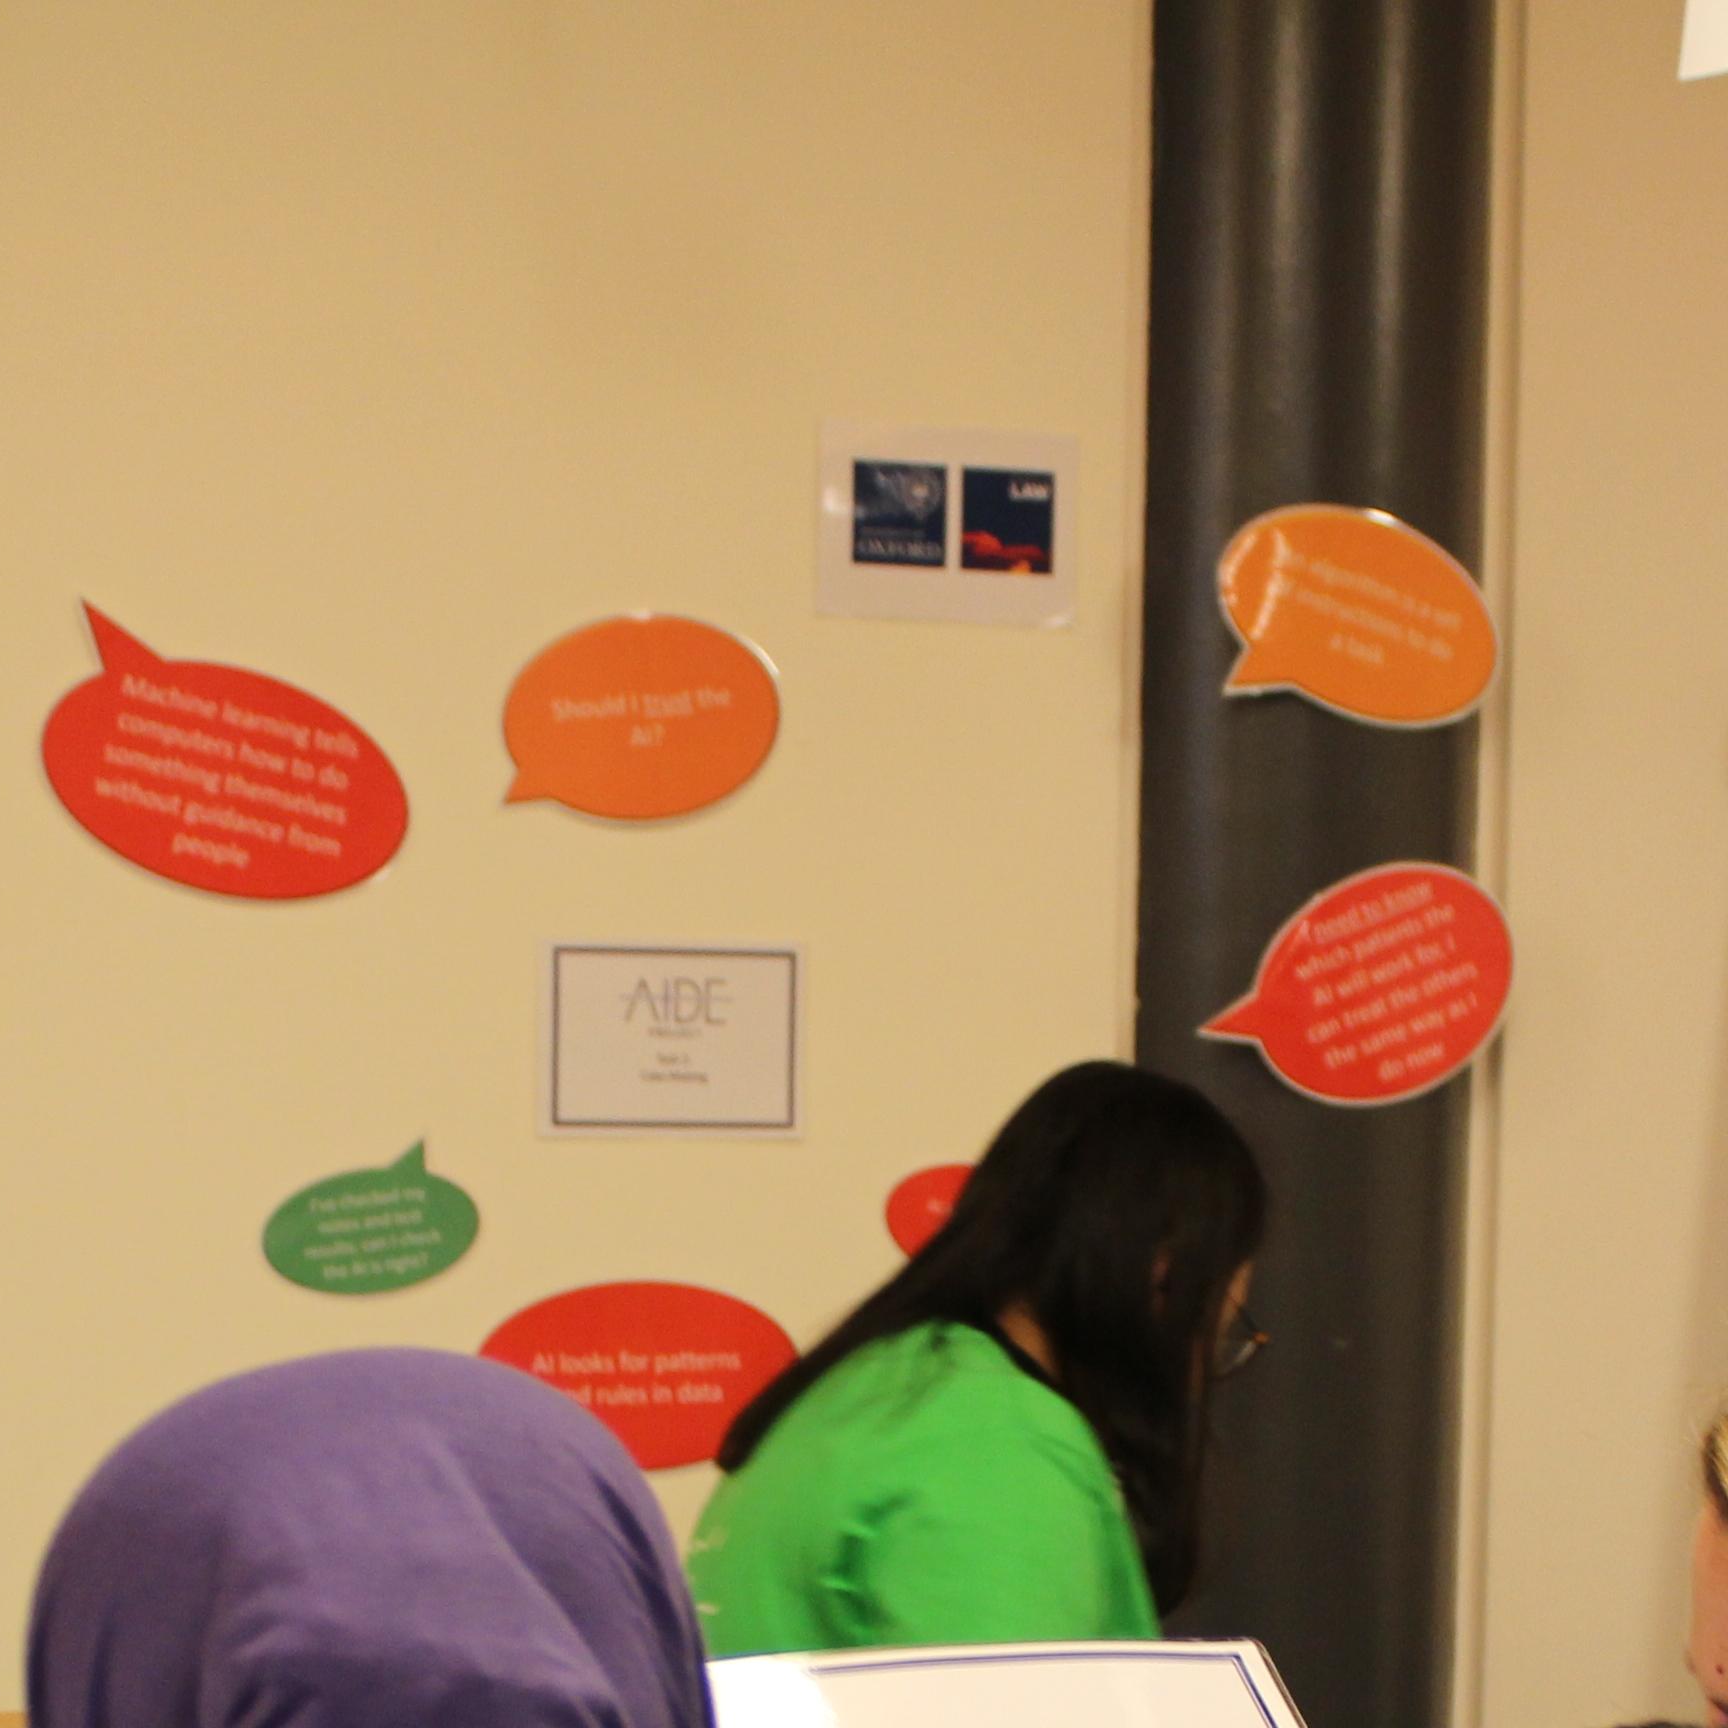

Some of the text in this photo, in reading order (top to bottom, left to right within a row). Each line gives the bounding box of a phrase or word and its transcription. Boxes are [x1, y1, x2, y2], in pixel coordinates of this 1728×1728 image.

[1008, 482, 1048, 500] LAW
[121, 673, 360, 759] Machine learning tells
[117, 711, 349, 791] computers how to do
[104, 743, 347, 826] something themselves
[94, 776, 342, 857] without guidance from
[172, 832, 250, 869] people
[624, 976, 728, 1025] AIDE
[531, 1350, 742, 1376] AI looks for patterns
[595, 1382, 724, 1405] rules in data
